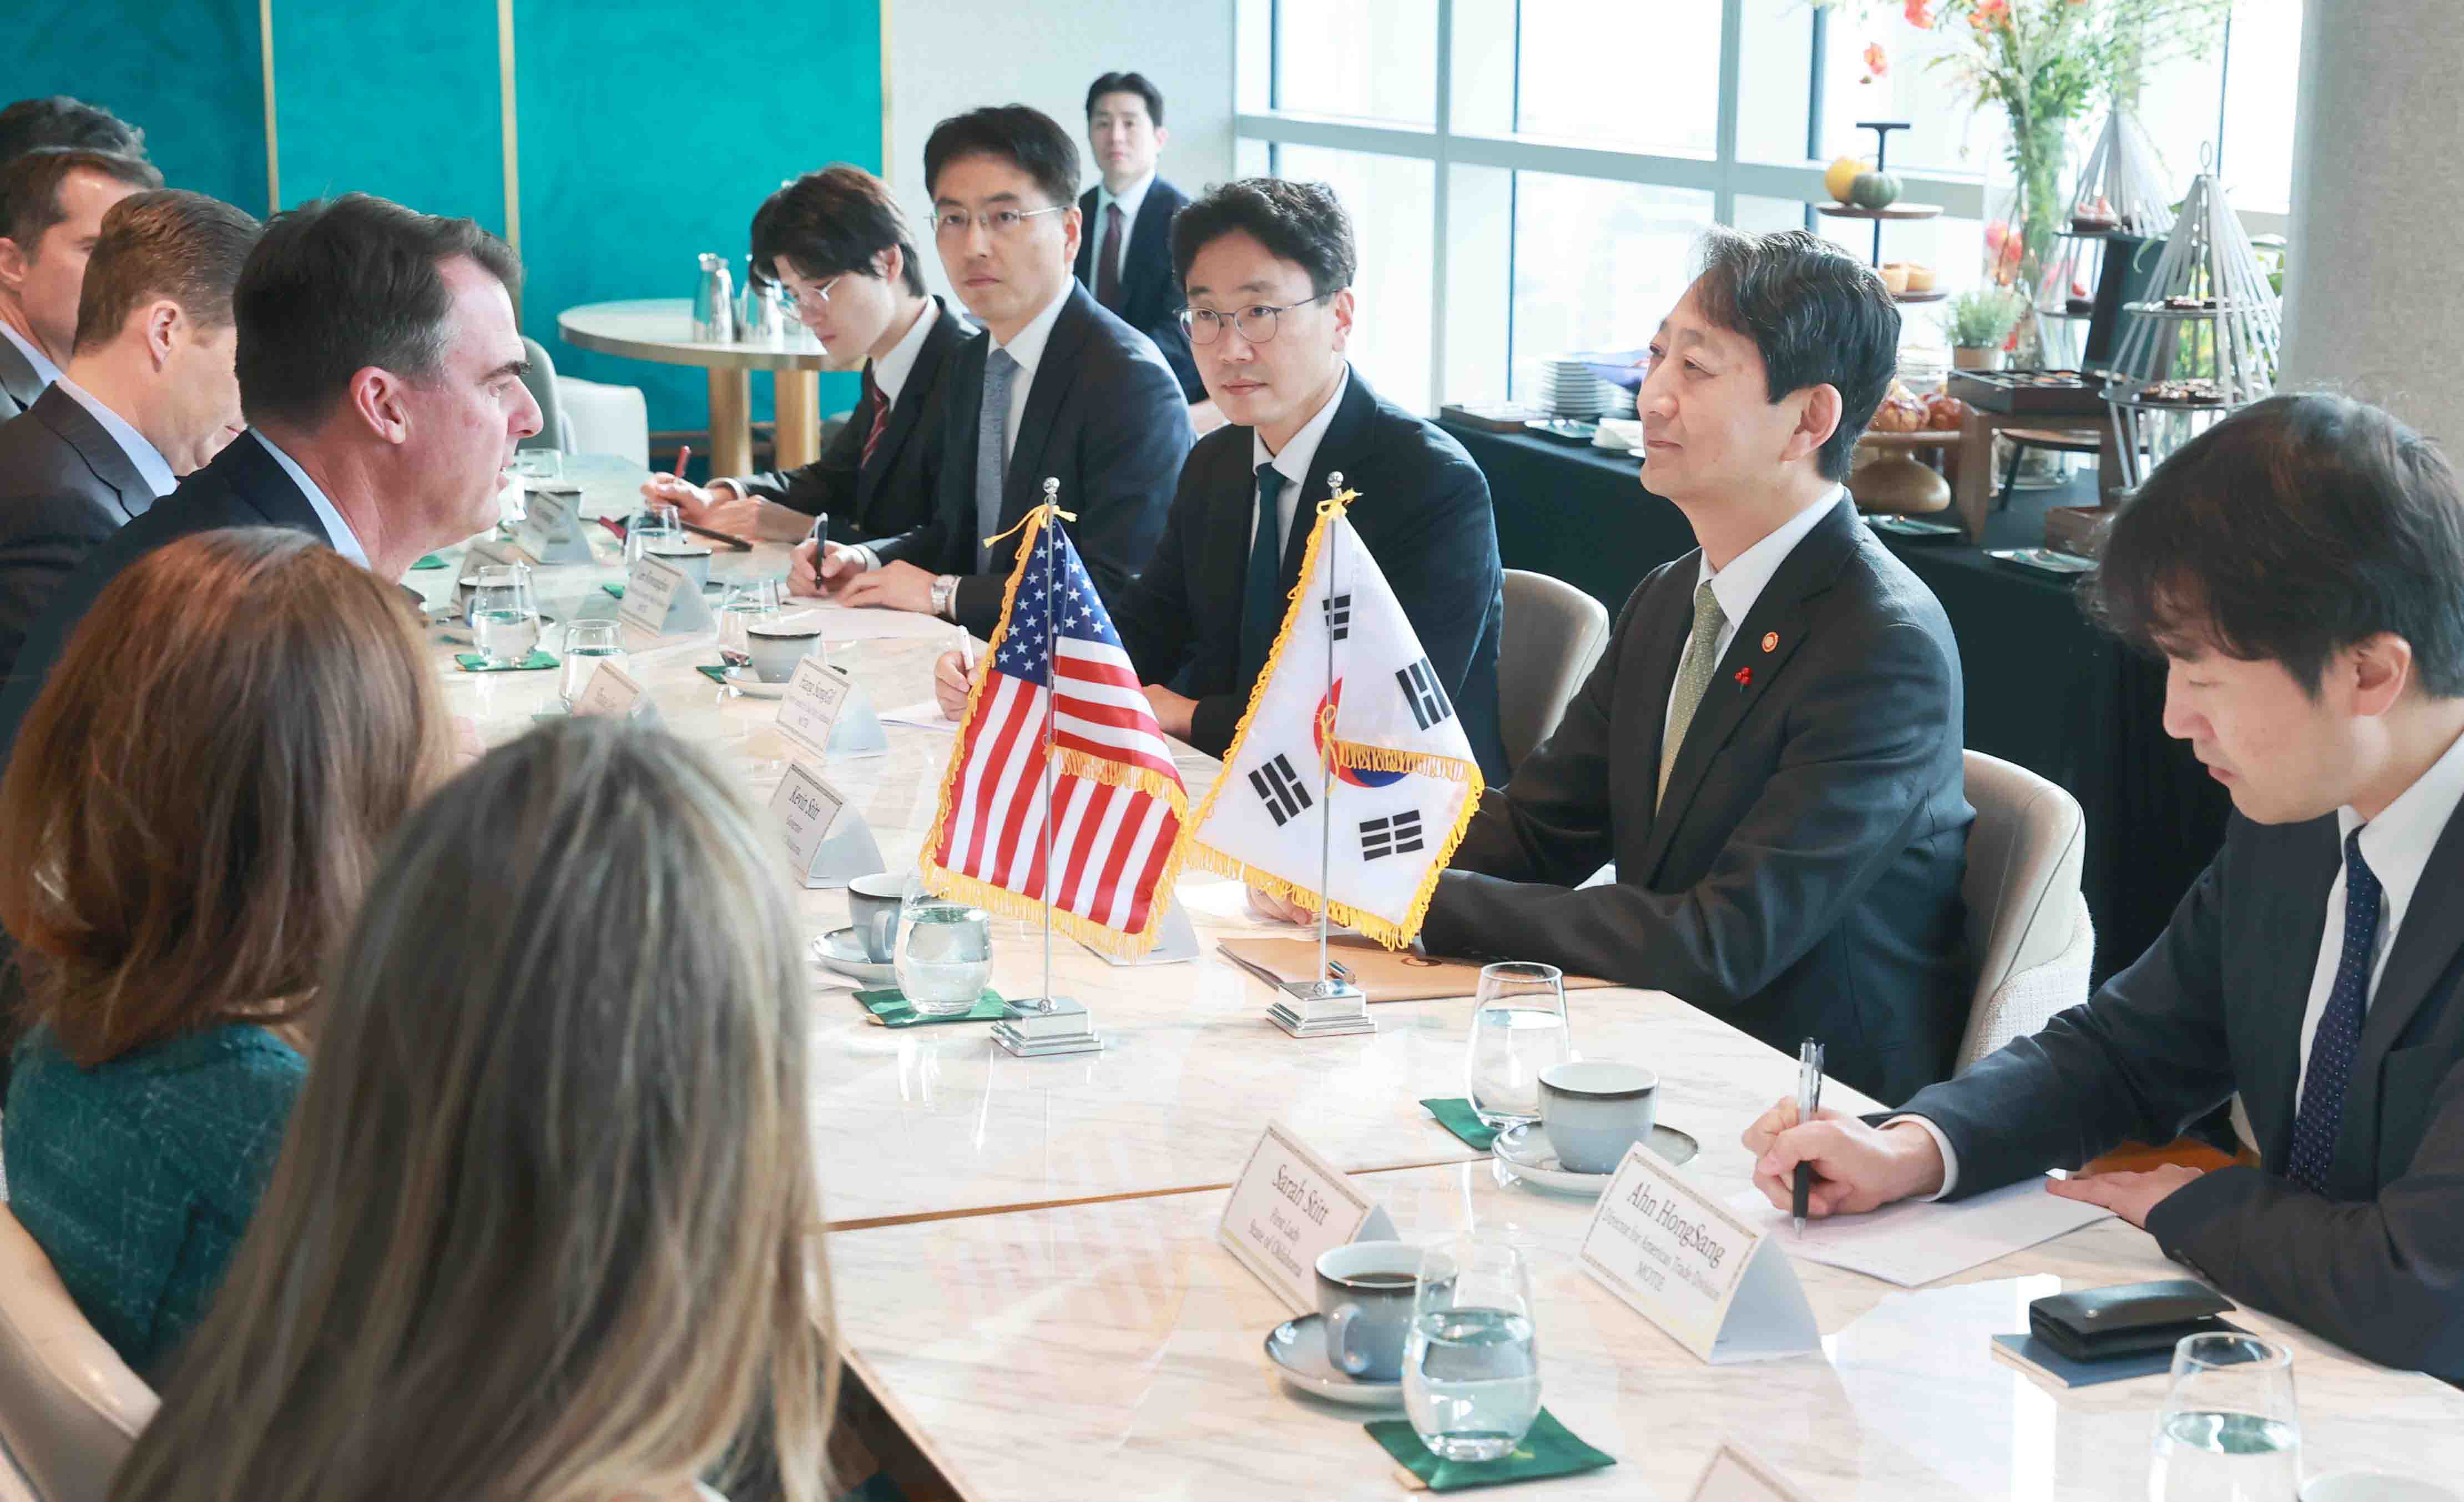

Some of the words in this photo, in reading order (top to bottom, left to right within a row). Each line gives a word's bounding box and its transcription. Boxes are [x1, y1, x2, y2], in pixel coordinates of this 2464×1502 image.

[789, 785, 807, 812] Kevin
[805, 799, 820, 821] Stitt
[1272, 1163, 1307, 1207] Sarah
[1302, 1189, 1329, 1226] Stitt
[1264, 1235, 1274, 1251] of
[1284, 1220, 1300, 1246] Lady
[1626, 1181, 1657, 1217] Ahn
[1655, 1199, 1726, 1269] HongSang
